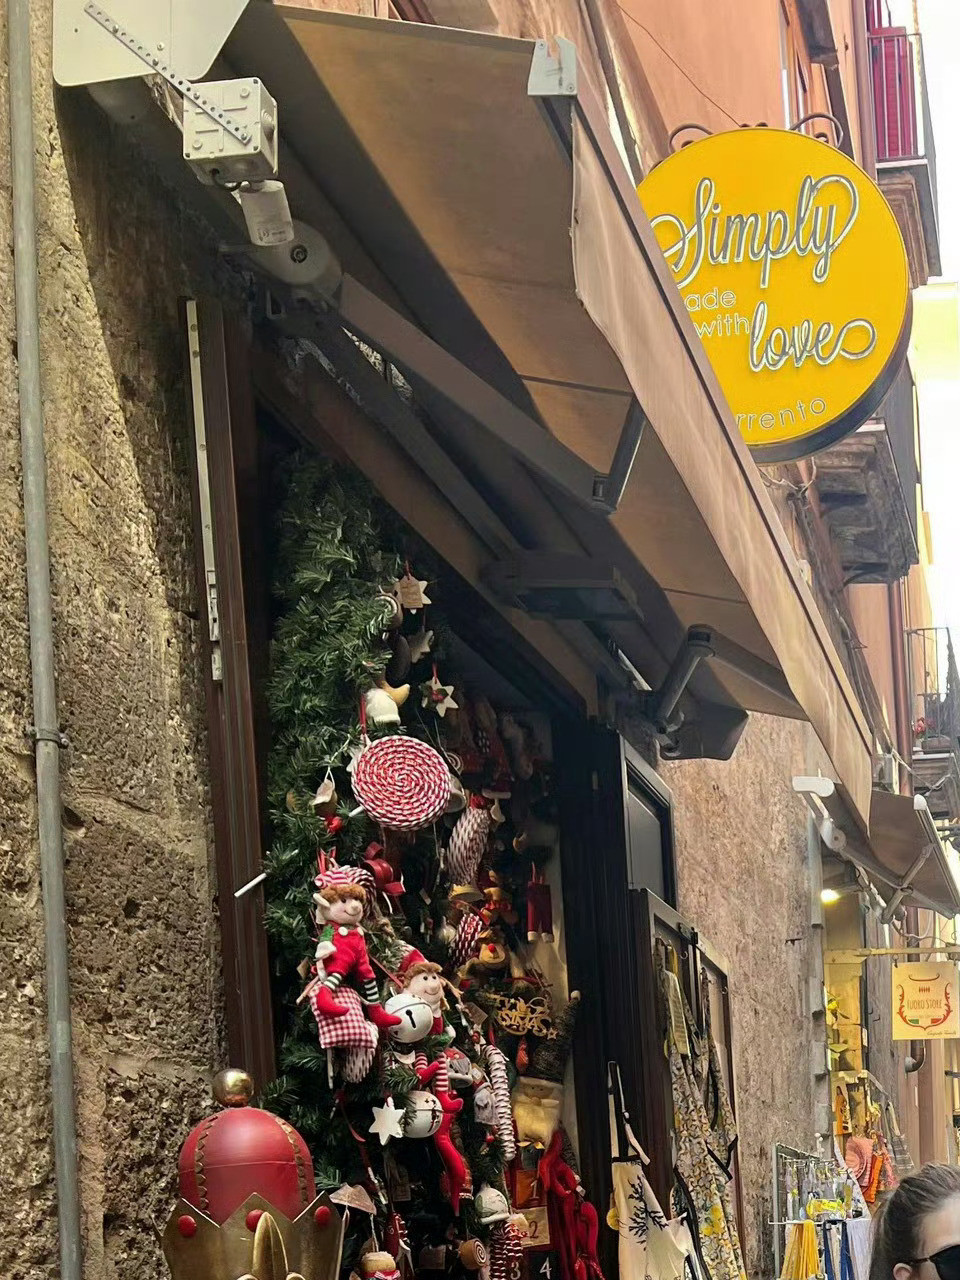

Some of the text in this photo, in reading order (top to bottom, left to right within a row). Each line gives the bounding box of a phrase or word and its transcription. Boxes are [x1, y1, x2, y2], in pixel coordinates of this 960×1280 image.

[650, 174, 860, 290] Simply
[685, 287, 737, 312] ade
[694, 300, 877, 373] with love
[736, 397, 827, 432] rrento
[529, 1220, 539, 1239] 2
[540, 1256, 552, 1280] 4
